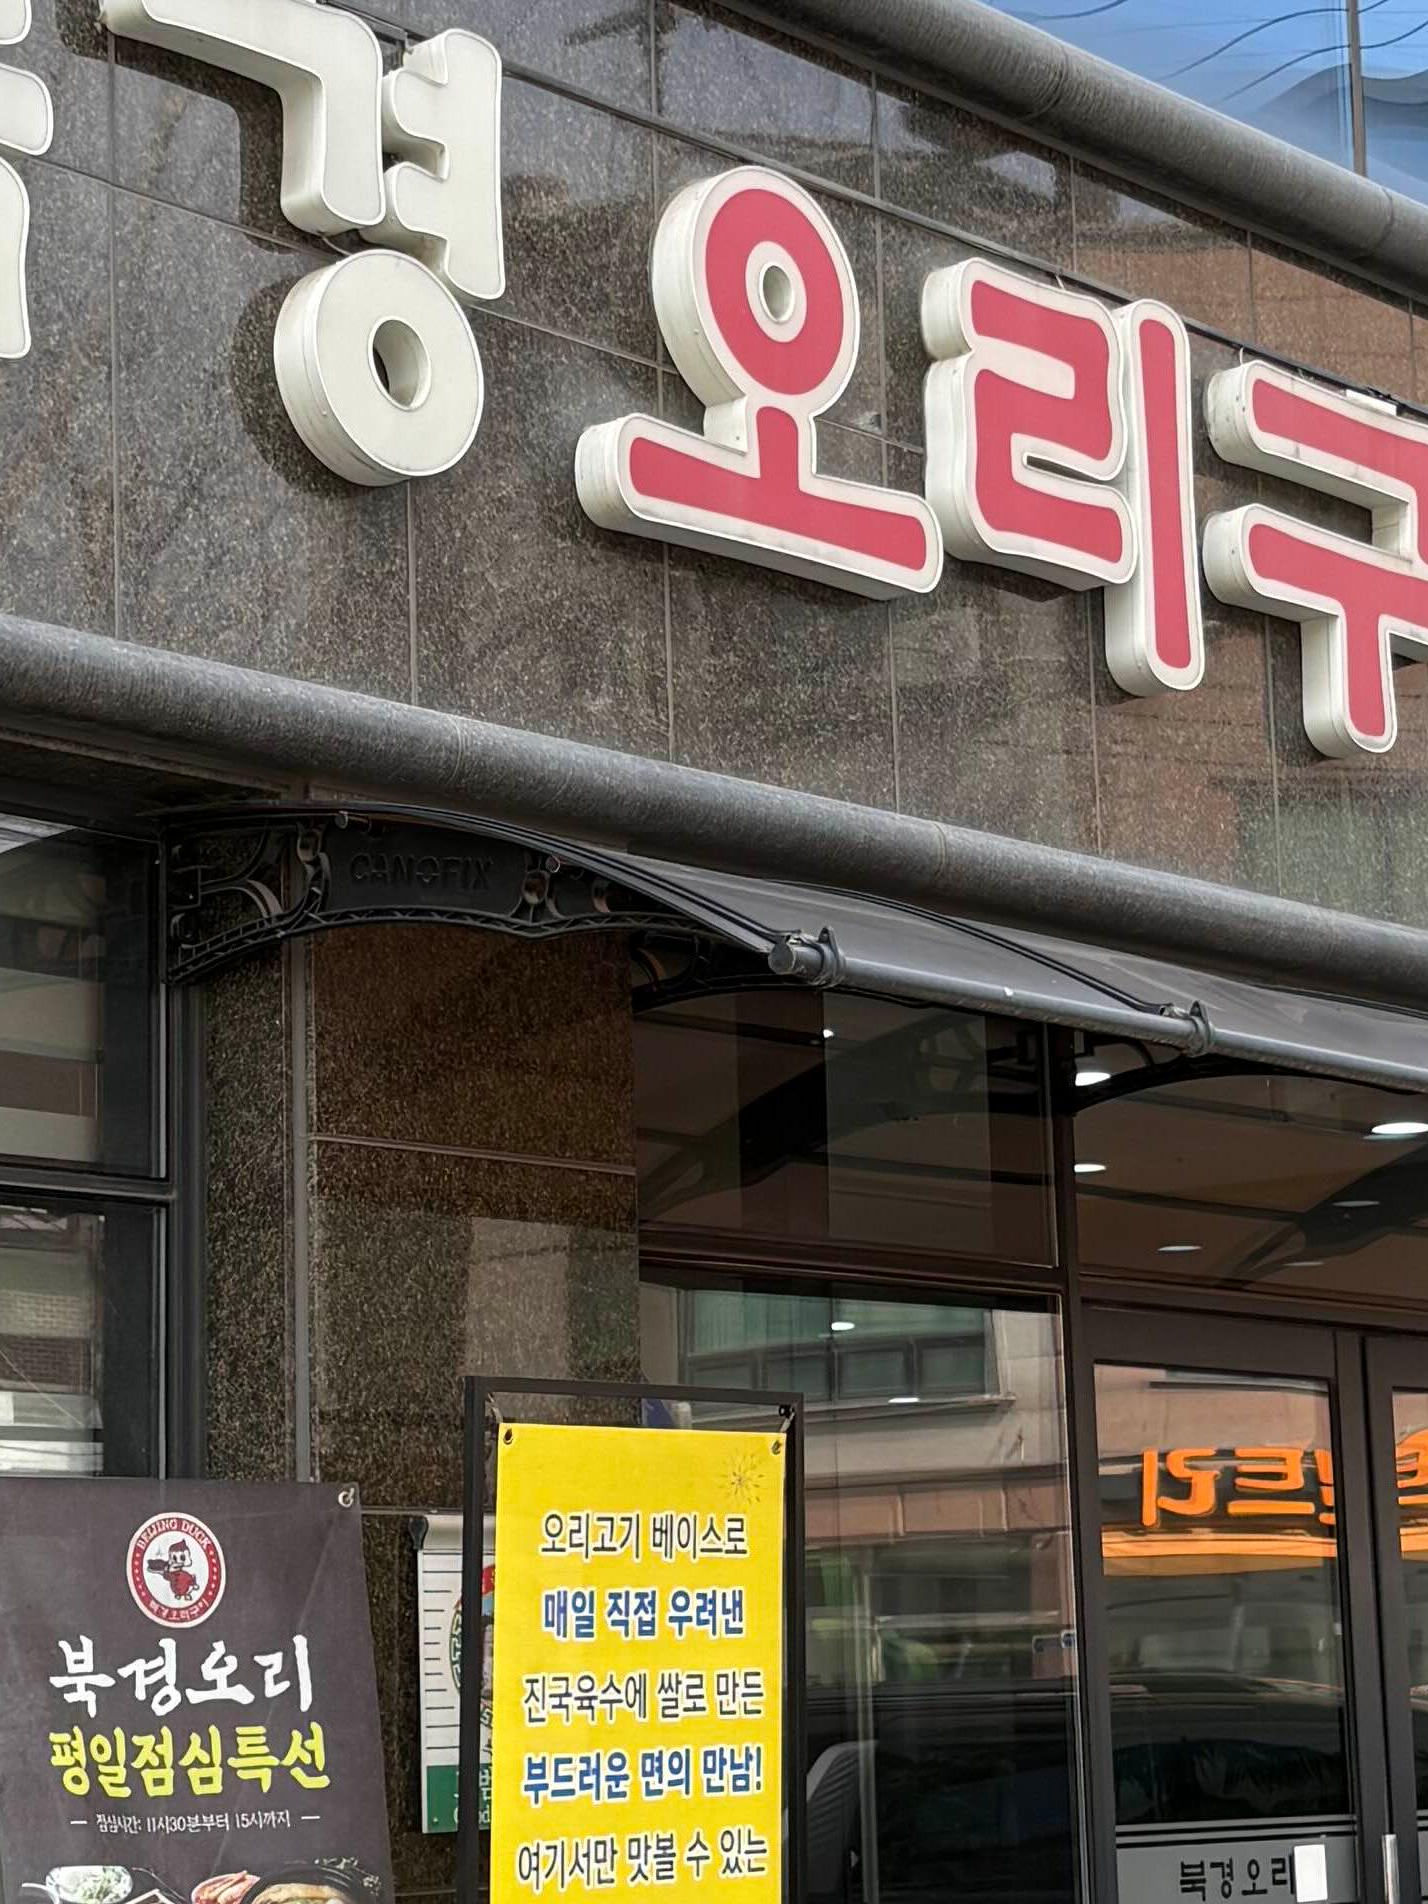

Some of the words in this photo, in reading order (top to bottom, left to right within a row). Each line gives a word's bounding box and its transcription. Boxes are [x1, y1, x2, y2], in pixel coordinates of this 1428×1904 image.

[180, 1519, 212, 1551] DUCK
[540, 1512, 641, 1559] 오리고기
[652, 1513, 749, 1559] 베이스로
[543, 1590, 596, 1639] 매일
[606, 1589, 658, 1638] 직접
[667, 1588, 745, 1637] 우려낸
[48, 1634, 313, 1719] 북경오리
[523, 1672, 648, 1724] 진국육수에
[656, 1672, 708, 1721] 쌀로
[715, 1670, 764, 1718] 만든
[48, 1721, 331, 1799] 평일점심특선
[523, 1751, 630, 1806] 부드러운
[640, 1747, 692, 1798] 면의
[702, 1745, 763, 1795] 만남!
[234, 1809, 291, 1829] 15시까지
[517, 1835, 618, 1891] 여기서만
[627, 1832, 678, 1883] 맛볼
[685, 1830, 711, 1878] 수
[719, 1826, 769, 1876] 있는
